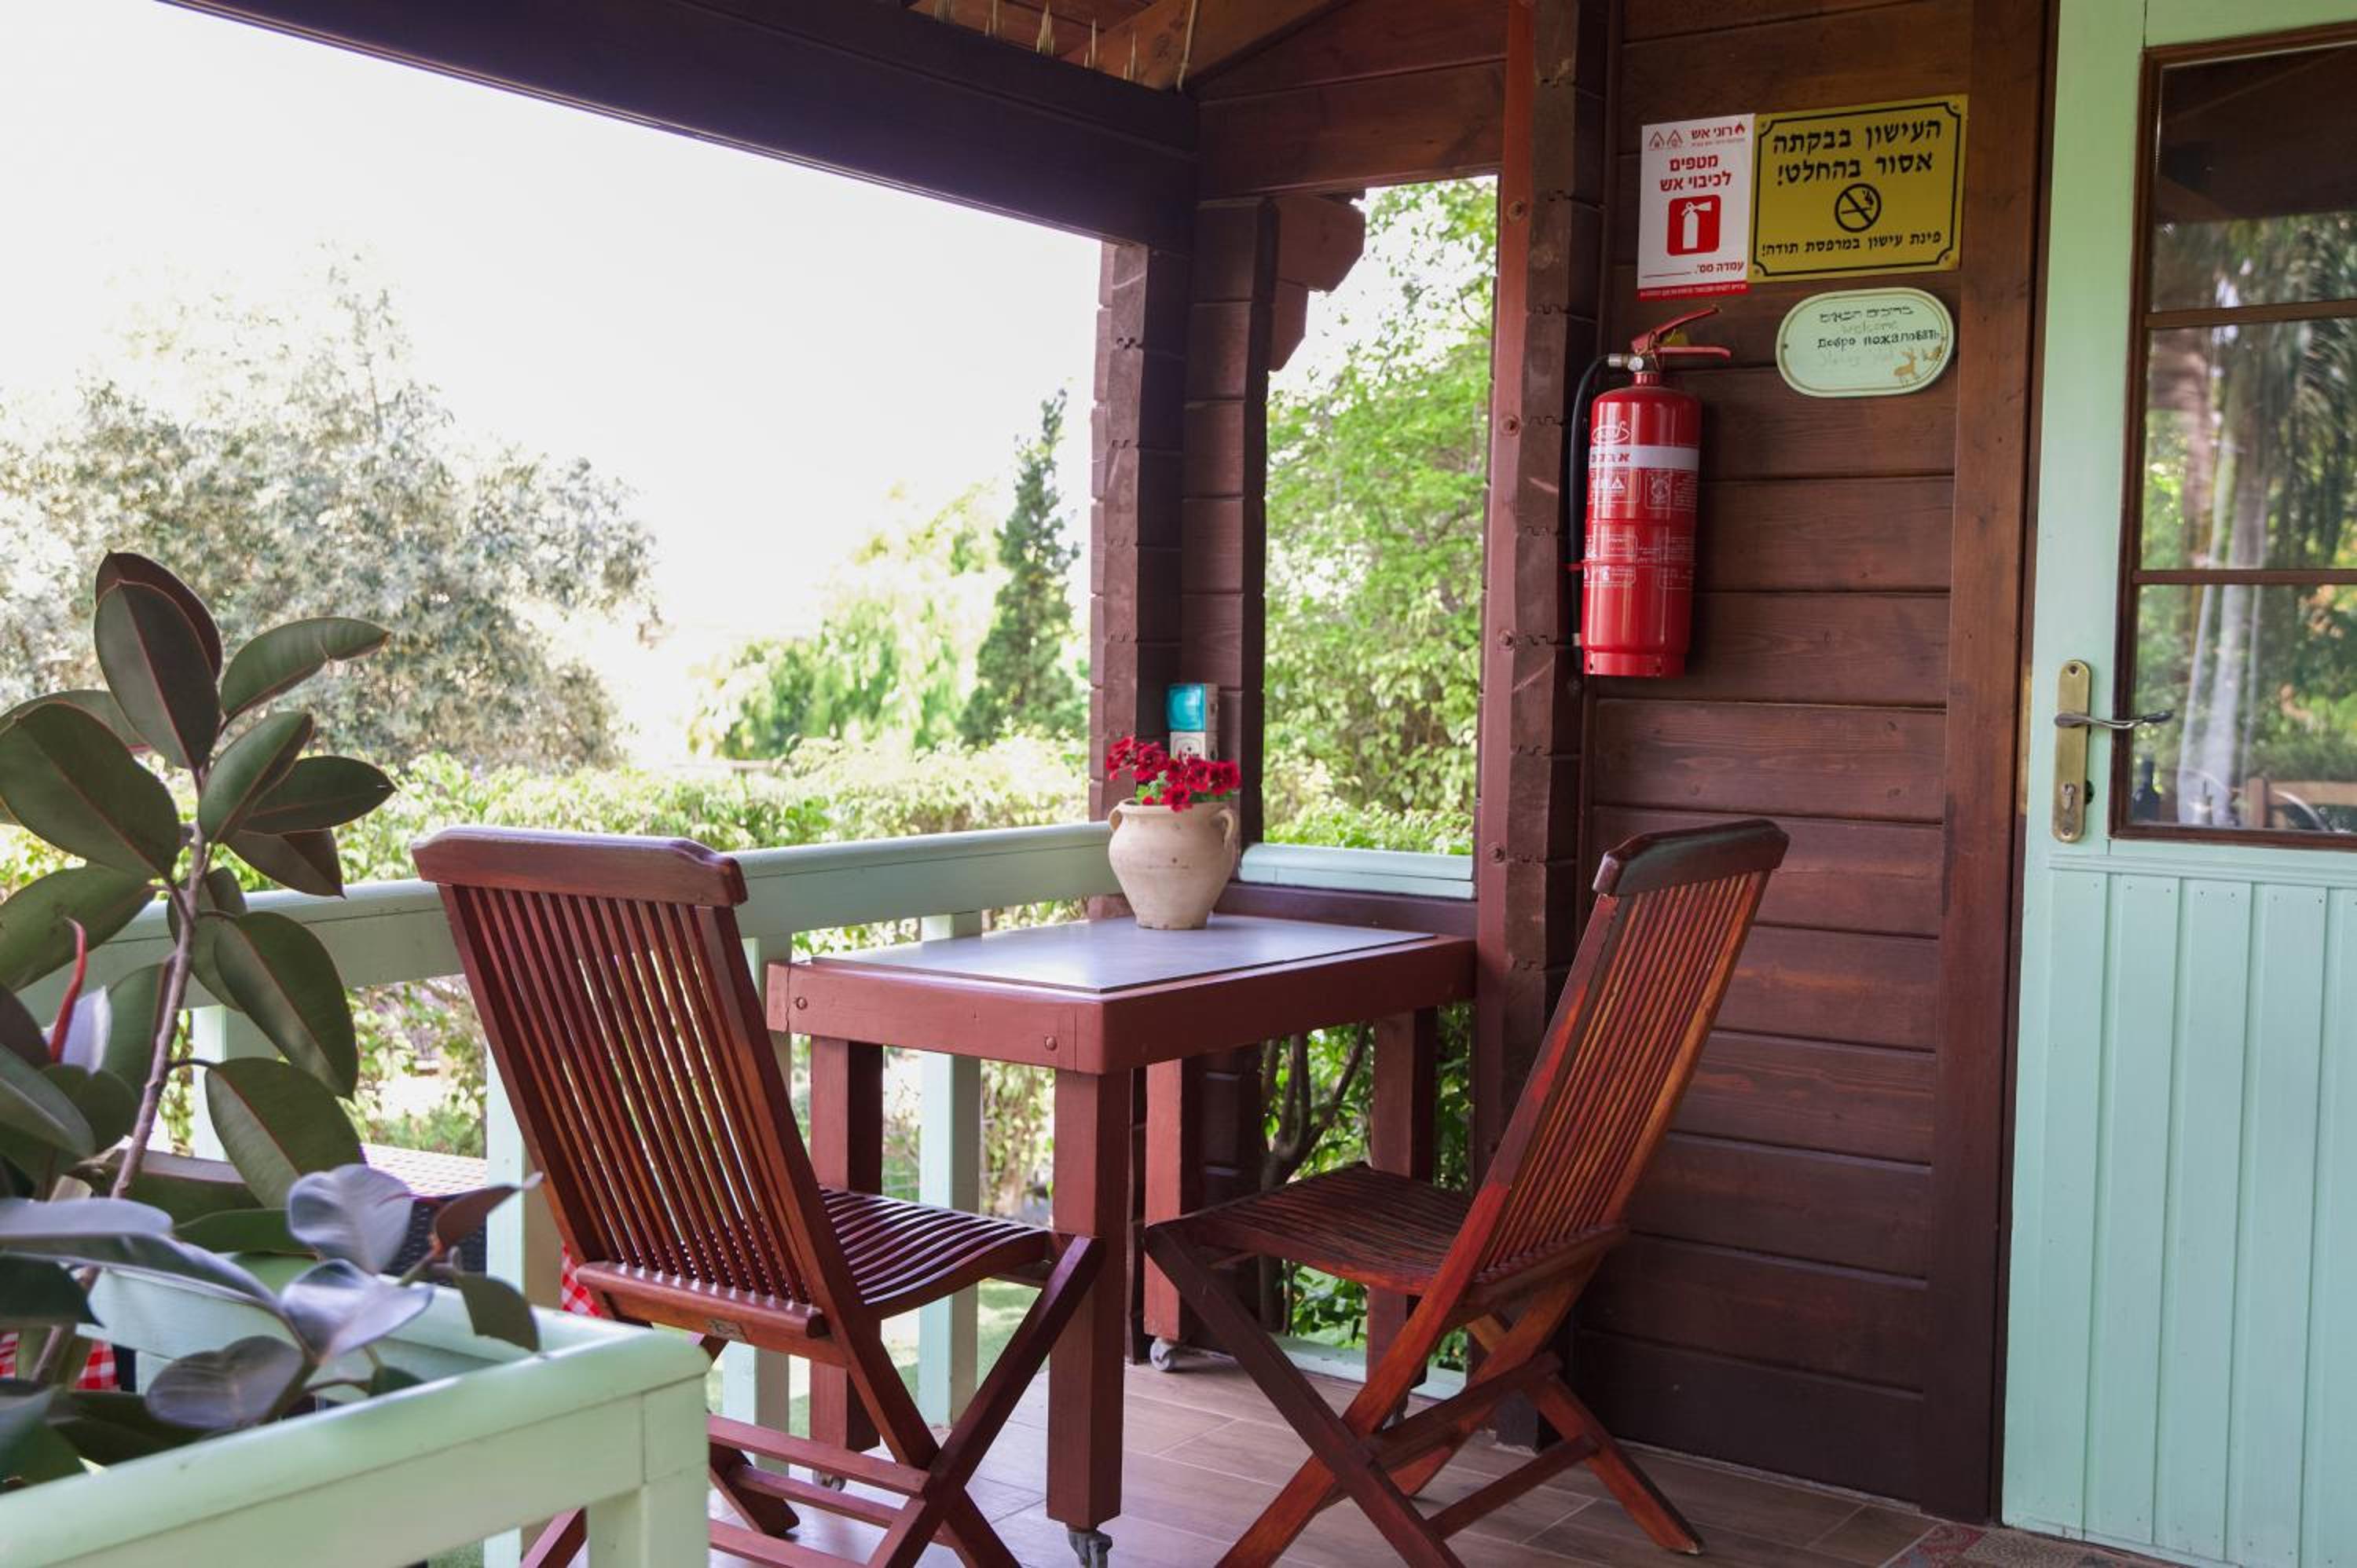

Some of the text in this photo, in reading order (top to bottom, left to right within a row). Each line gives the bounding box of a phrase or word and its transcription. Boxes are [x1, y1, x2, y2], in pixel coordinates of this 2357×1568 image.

[1692, 128, 1711, 140] אש
[1772, 119, 1941, 155] העישון בבקתה
[1670, 155, 1719, 172] מטפים
[1777, 152, 1934, 186] אסור בהחלט!
[1660, 170, 1732, 192] לכיבוי אש
[1761, 230, 1942, 257] פינת עישון במרפסת תודה!
